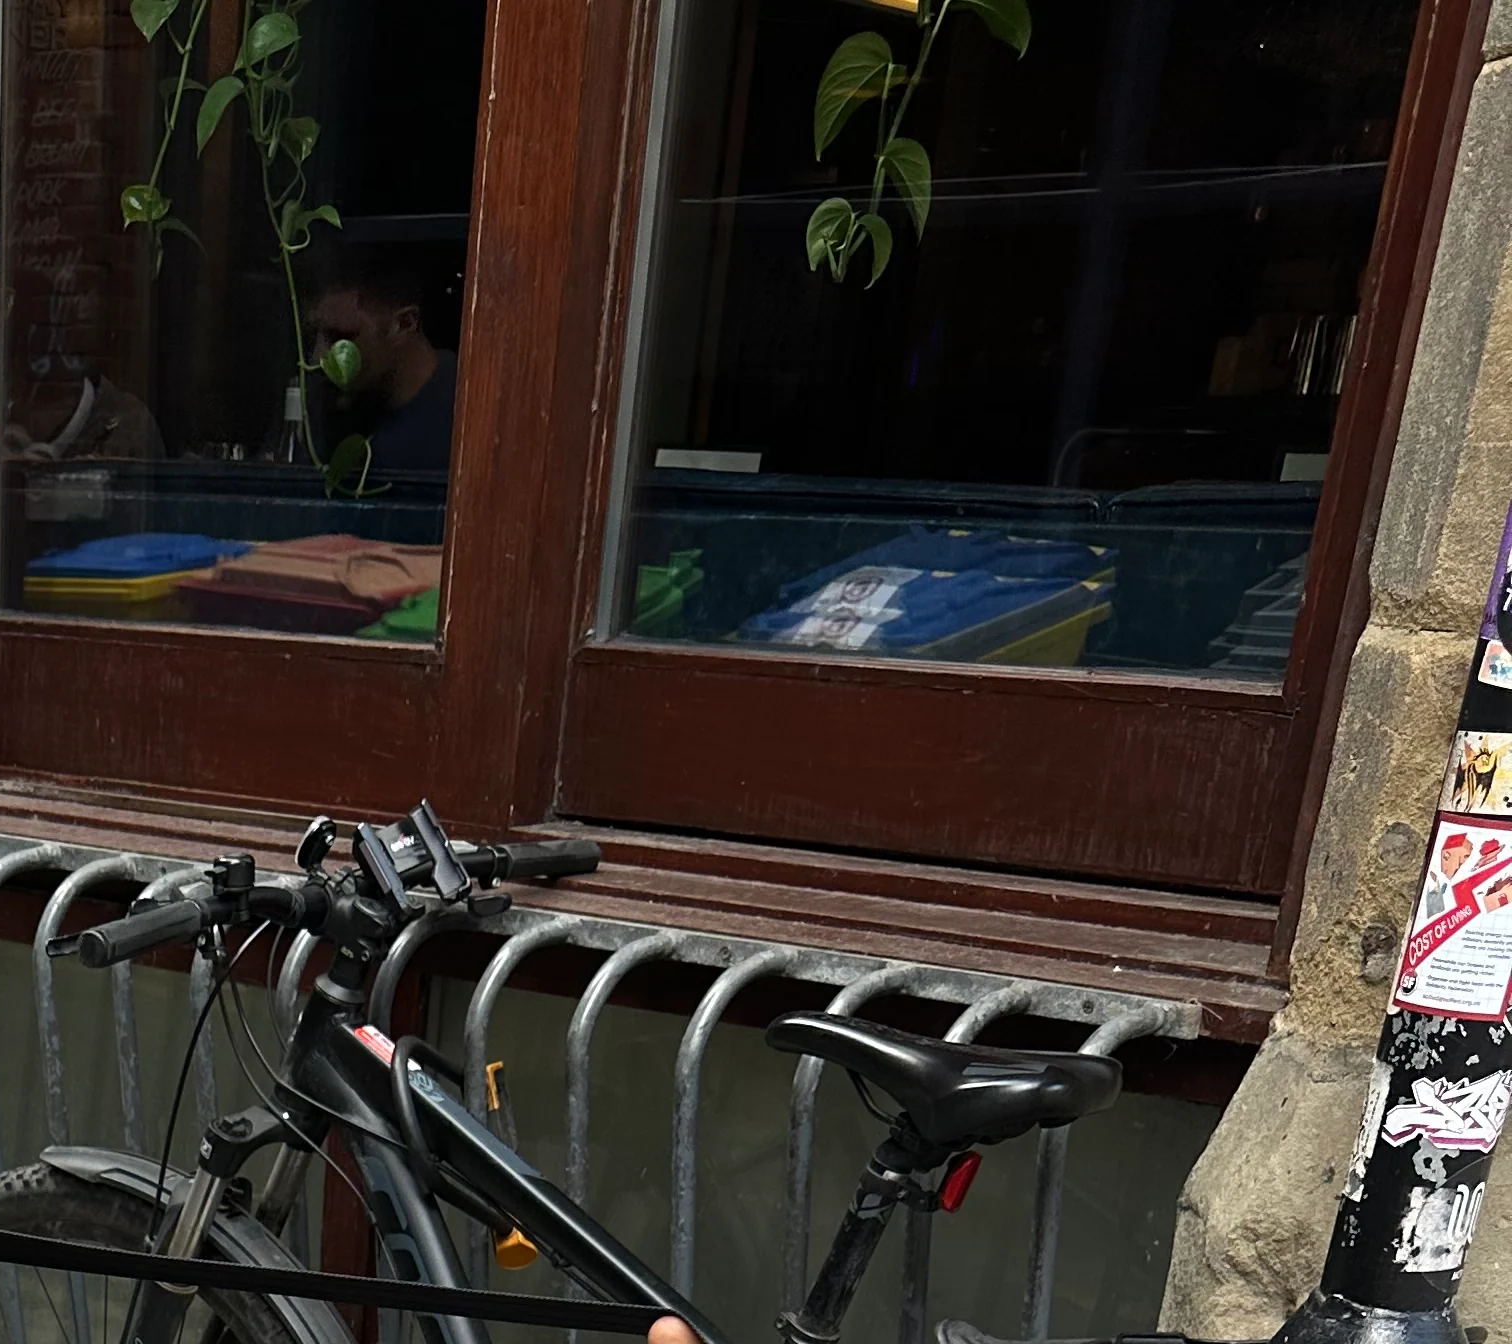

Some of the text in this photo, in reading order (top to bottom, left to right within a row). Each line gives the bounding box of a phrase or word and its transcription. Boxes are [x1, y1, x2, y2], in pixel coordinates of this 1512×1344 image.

[1409, 905, 1473, 965] COST OF LIVING
